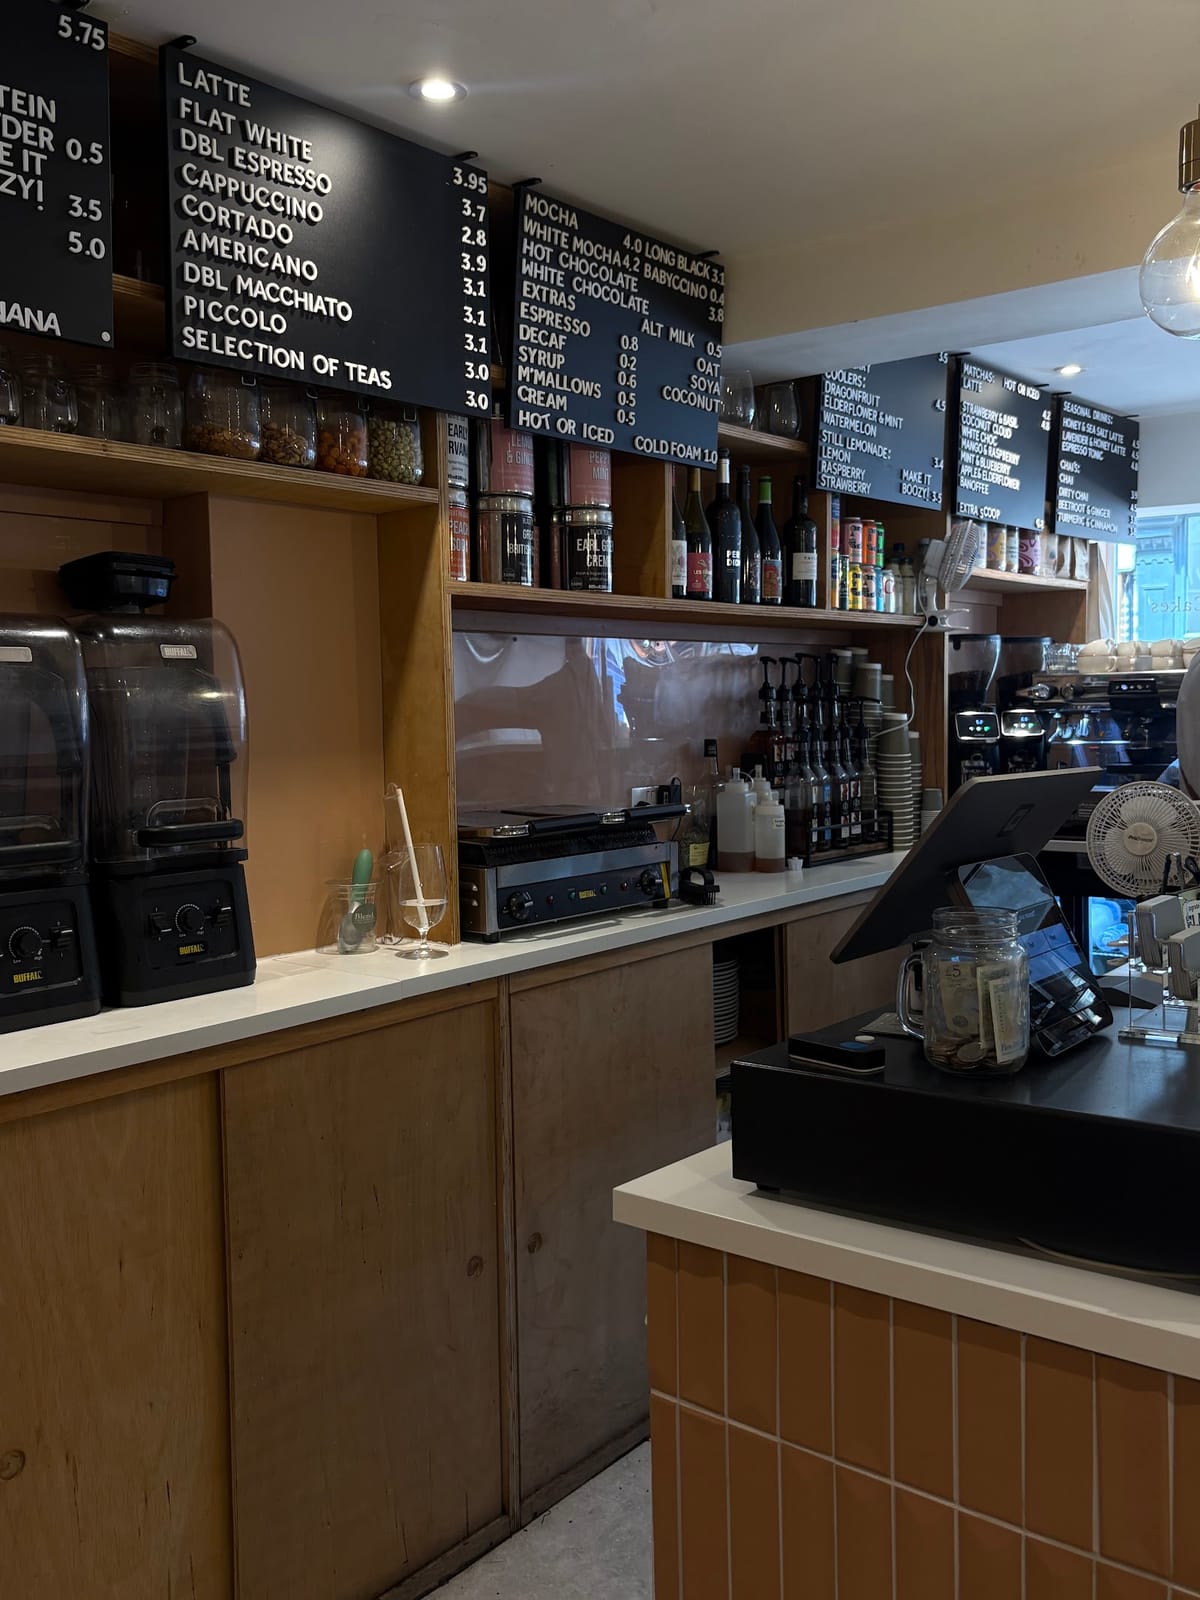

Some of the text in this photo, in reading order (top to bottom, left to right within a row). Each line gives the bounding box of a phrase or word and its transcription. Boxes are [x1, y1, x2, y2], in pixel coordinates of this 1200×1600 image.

[58, 14, 106, 51] 5.75
[0, 112, 104, 164] DER 0.5
[178, 62, 488, 194] LATTE 3.95
[22, 148, 48, 176] IT
[180, 97, 486, 222] FLAT WHITE 3.7
[180, 127, 487, 247] DBL ESPRESSO 2.8
[68, 194, 102, 221] 3.5
[182, 162, 487, 272] CAPPUCCINO 3.9
[68, 231, 106, 259] 5.0
[181, 194, 486, 298] CORTADO 3.1
[525, 194, 725, 286] MOCHA 4.0 LONG BLACK 3.1
[183, 229, 487, 327] AMERICANO 3.1
[523, 215, 725, 306] WHITE MOCHA 4.2 BABYCCINO 0.4
[521, 258, 650, 316] WHITE CHOCOLATE
[522, 239, 725, 323] HOT CHOCOLATE 3.8
[183, 261, 487, 354] DBL MACCHIATO 3.1
[522, 280, 723, 359] EXTRAS ALT MILK 0.5
[184, 295, 489, 381] PICCOLO 3.0
[520, 301, 720, 377] ESPRESSO 0.8 OAT
[182, 326, 489, 410] SELECTION OF TEAS 3.0
[519, 324, 721, 396] DECAF 0.2 SOYA
[517, 365, 636, 408] M'MALLOWS 0.5
[518, 345, 720, 413] SYRUP 0.6 COCONUT
[824, 381, 881, 407] DRAGONFRUIT
[963, 363, 1040, 400] MATCHAS: HOT OR ICED
[963, 376, 982, 393] LATTE
[517, 385, 636, 426] CREAM 0.5
[823, 410, 877, 437] WATERMELON
[824, 395, 877, 421] ELDERFLOWER
[885, 413, 904, 430] MINT
[962, 401, 998, 423] STRAWBERRY
[1063, 400, 1091, 419] SEASONAL
[518, 410, 718, 464] HOT OR ICED COLD FOAM 1.0
[961, 425, 998, 446] WHITE CHOC
[962, 413, 991, 432] COCONUT
[992, 424, 1012, 439] CLOUD
[822, 430, 844, 447] STILL
[846, 437, 892, 460] LEMONADE:
[822, 446, 851, 463] LEMON
[960, 450, 975, 464] MINT
[980, 456, 1012, 476] BLUEBERRY
[961, 438, 983, 454] MANGO
[988, 446, 1020, 466] RASPBERRY
[820, 474, 872, 494] STRAWBERRY
[902, 483, 930, 501] BOOZY!
[821, 461, 932, 485] RASPBERRY MAKE IT
[960, 476, 989, 495] BANOFFEE
[982, 470, 1020, 491] ELDERFLOWER
[960, 502, 978, 516] EXTRA
[577, 537, 600, 552] EARL
